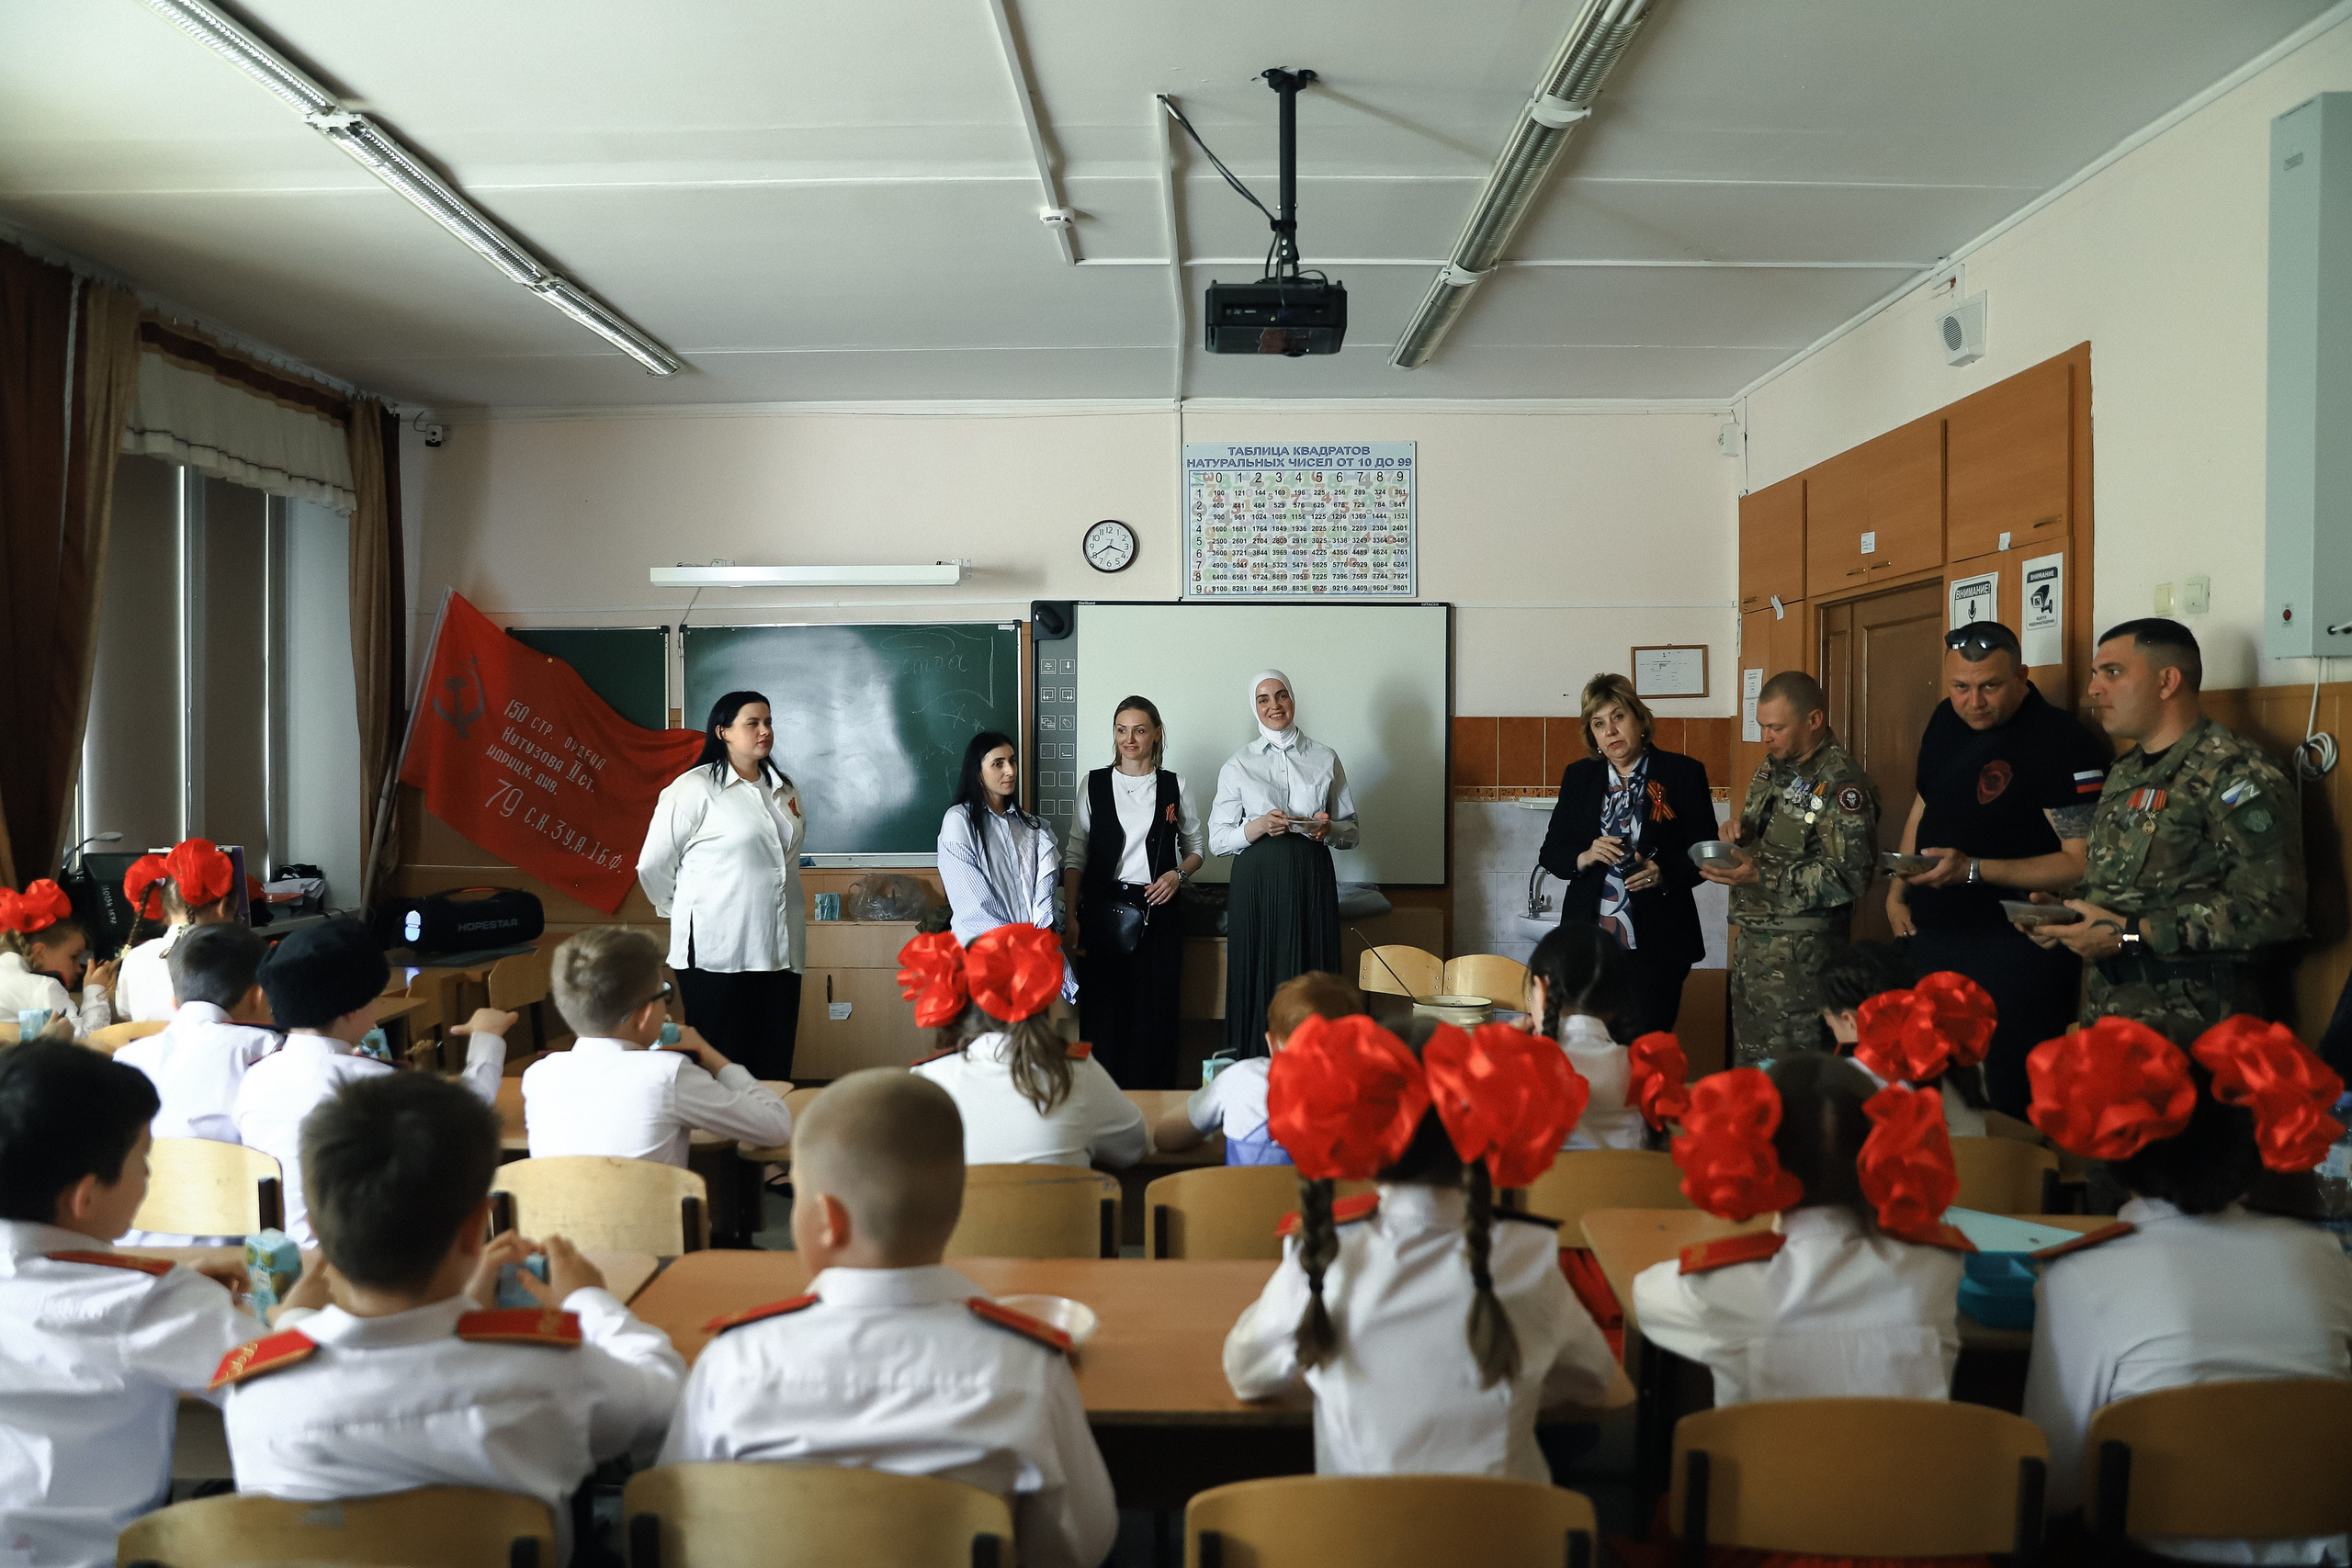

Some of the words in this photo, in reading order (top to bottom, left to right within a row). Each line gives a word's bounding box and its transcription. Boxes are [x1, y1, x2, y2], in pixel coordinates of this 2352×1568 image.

[1227, 446, 1289, 457] ТАБЛИЦА
[1293, 446, 1370, 457] КВАДРАТОВ
[1187, 459, 1285, 468] НАТУРАЛЬНЫХ
[1288, 458, 1333, 467] ЧИСЕЛ
[1336, 458, 1354, 467] ОТ
[1358, 458, 1371, 466] 10
[1374, 458, 1394, 468] ДО
[1398, 458, 1412, 466] 99
[1215, 472, 1223, 483] 0
[1237, 472, 1242, 483] 1
[1255, 472, 1262, 483] 2
[1275, 472, 1282, 483] 3
[1295, 472, 1302, 483] 4
[1315, 471, 1323, 483] 5
[1336, 471, 1343, 483] 6
[1357, 471, 1364, 483] 7
[1376, 471, 1384, 482] 8
[1396, 471, 1404, 482] 9
[1197, 489, 1201, 498] 1
[1196, 501, 1202, 510] 2
[1196, 512, 1202, 522] 3
[1196, 525, 1202, 533] 4
[1196, 537, 1202, 546] 5
[1196, 549, 1202, 558] 6
[1196, 561, 1202, 570] 7
[1195, 572, 1202, 582] 8
[2030, 570, 2054, 581] ВНИМАНИЕ
[1196, 584, 1202, 594] 9
[1956, 583, 1990, 599] ВНИМАНИЕ!
[504, 699, 530, 722] 150
[531, 717, 556, 739] СТР.
[564, 736, 607, 771] ОРДЕНА
[486, 744, 532, 780] ИДРИЦК.
[535, 773, 558, 795] ДИВ.
[2244, 784, 2261, 797] Z
[485, 778, 524, 817] 79
[458, 918, 518, 932] HOPESTAR
